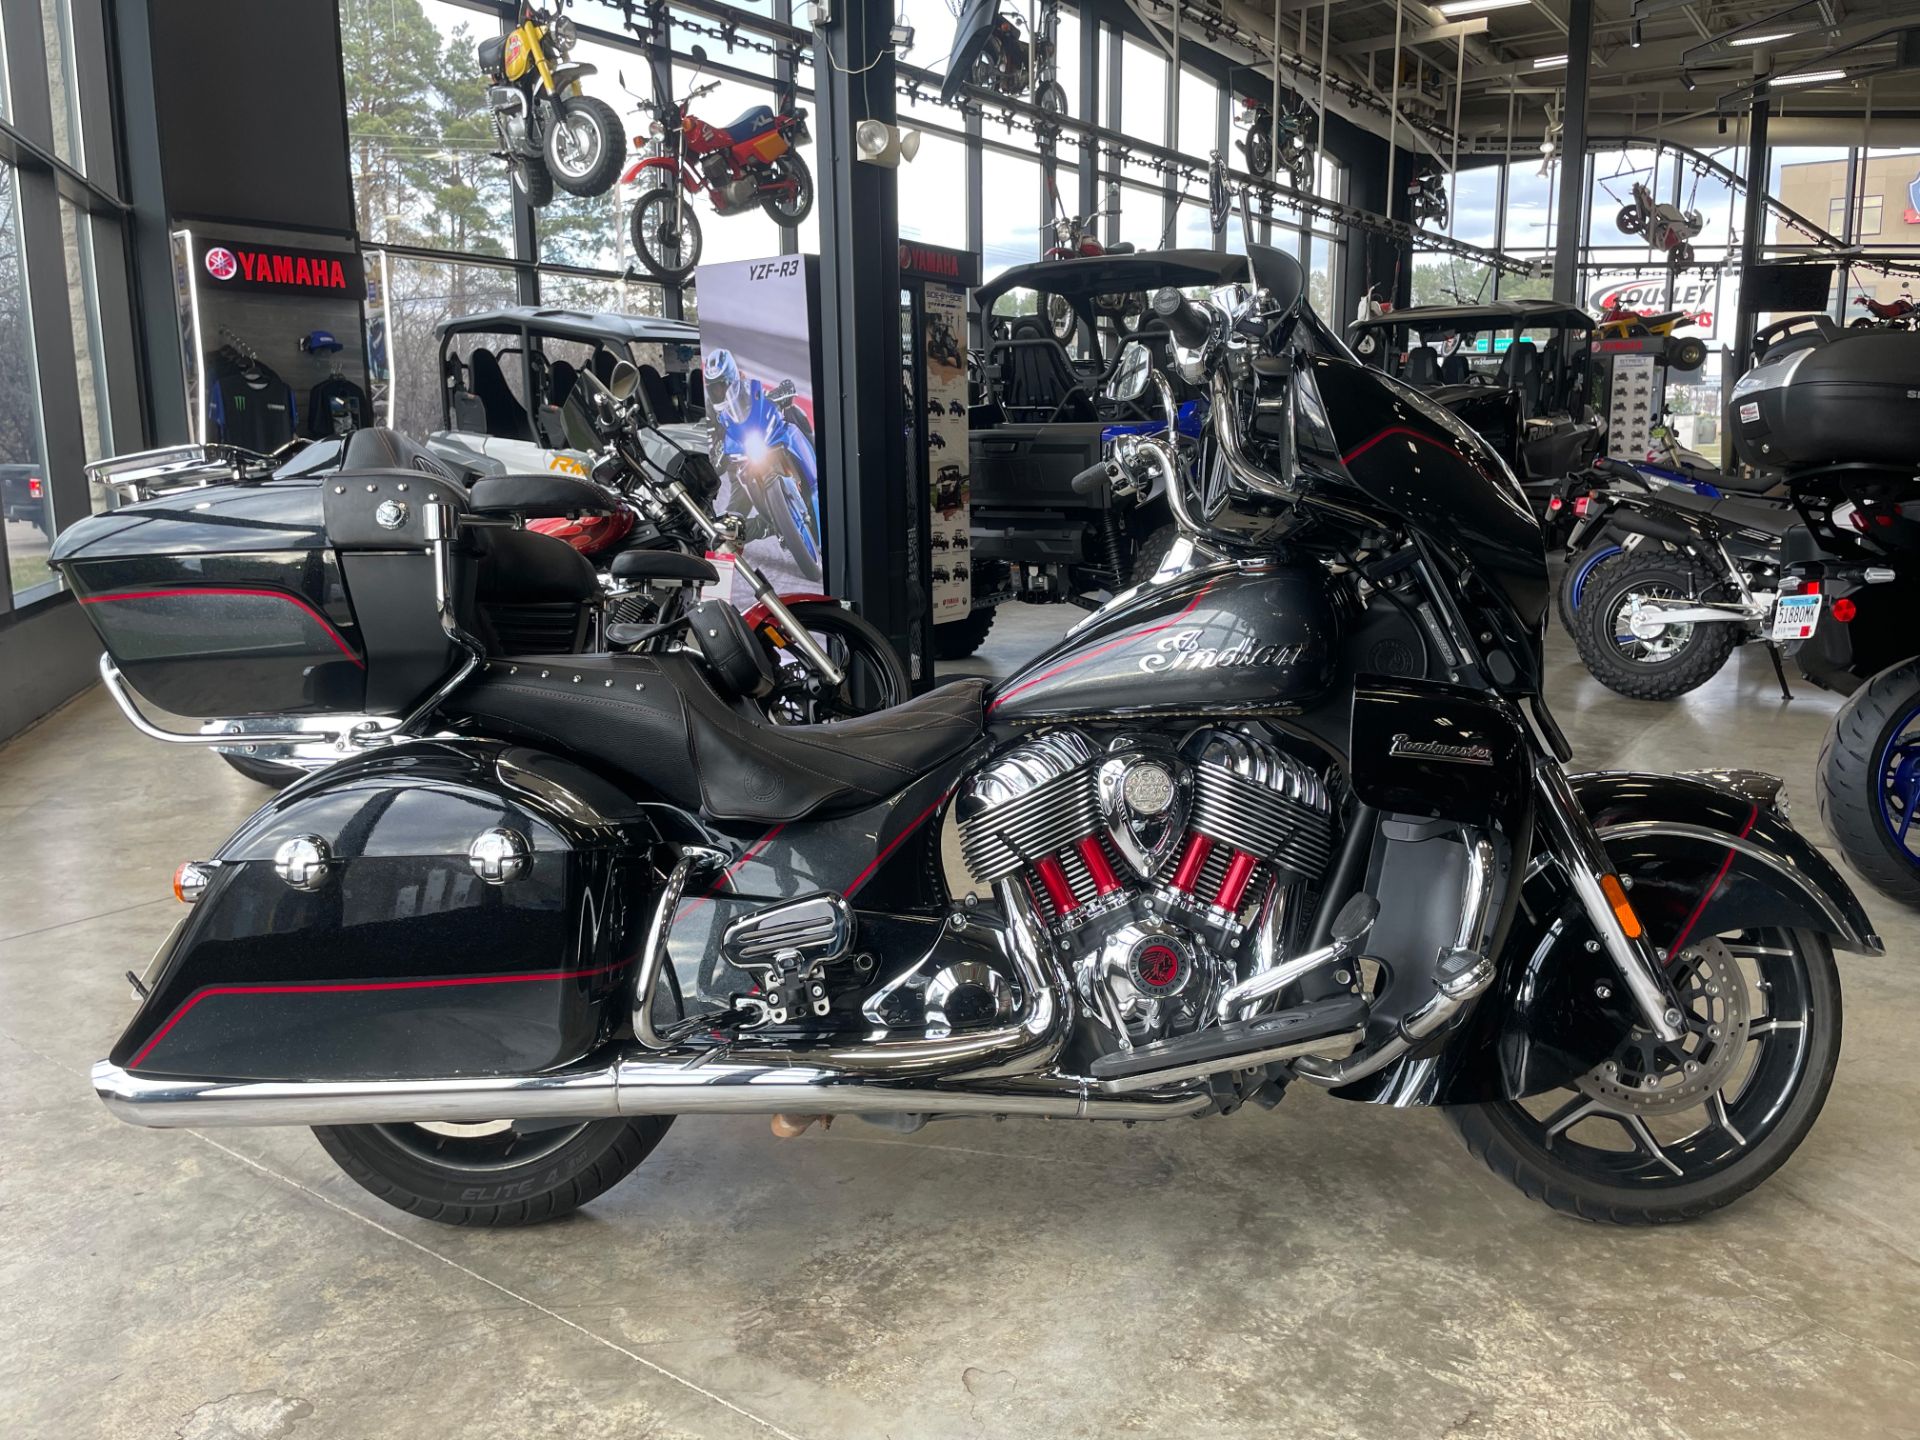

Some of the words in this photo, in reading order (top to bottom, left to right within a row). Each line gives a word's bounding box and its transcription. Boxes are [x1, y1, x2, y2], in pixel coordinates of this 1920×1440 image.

[752, 114, 775, 131] XL
[238, 251, 346, 289] YAMAHA
[749, 259, 799, 281] YZF-R3
[911, 246, 960, 276] YAMAHA
[1138, 629, 1304, 674] Indian
[1389, 733, 1493, 761] Roadmaster
[461, 1178, 536, 1201] ELITE
[545, 1167, 560, 1184] 4
